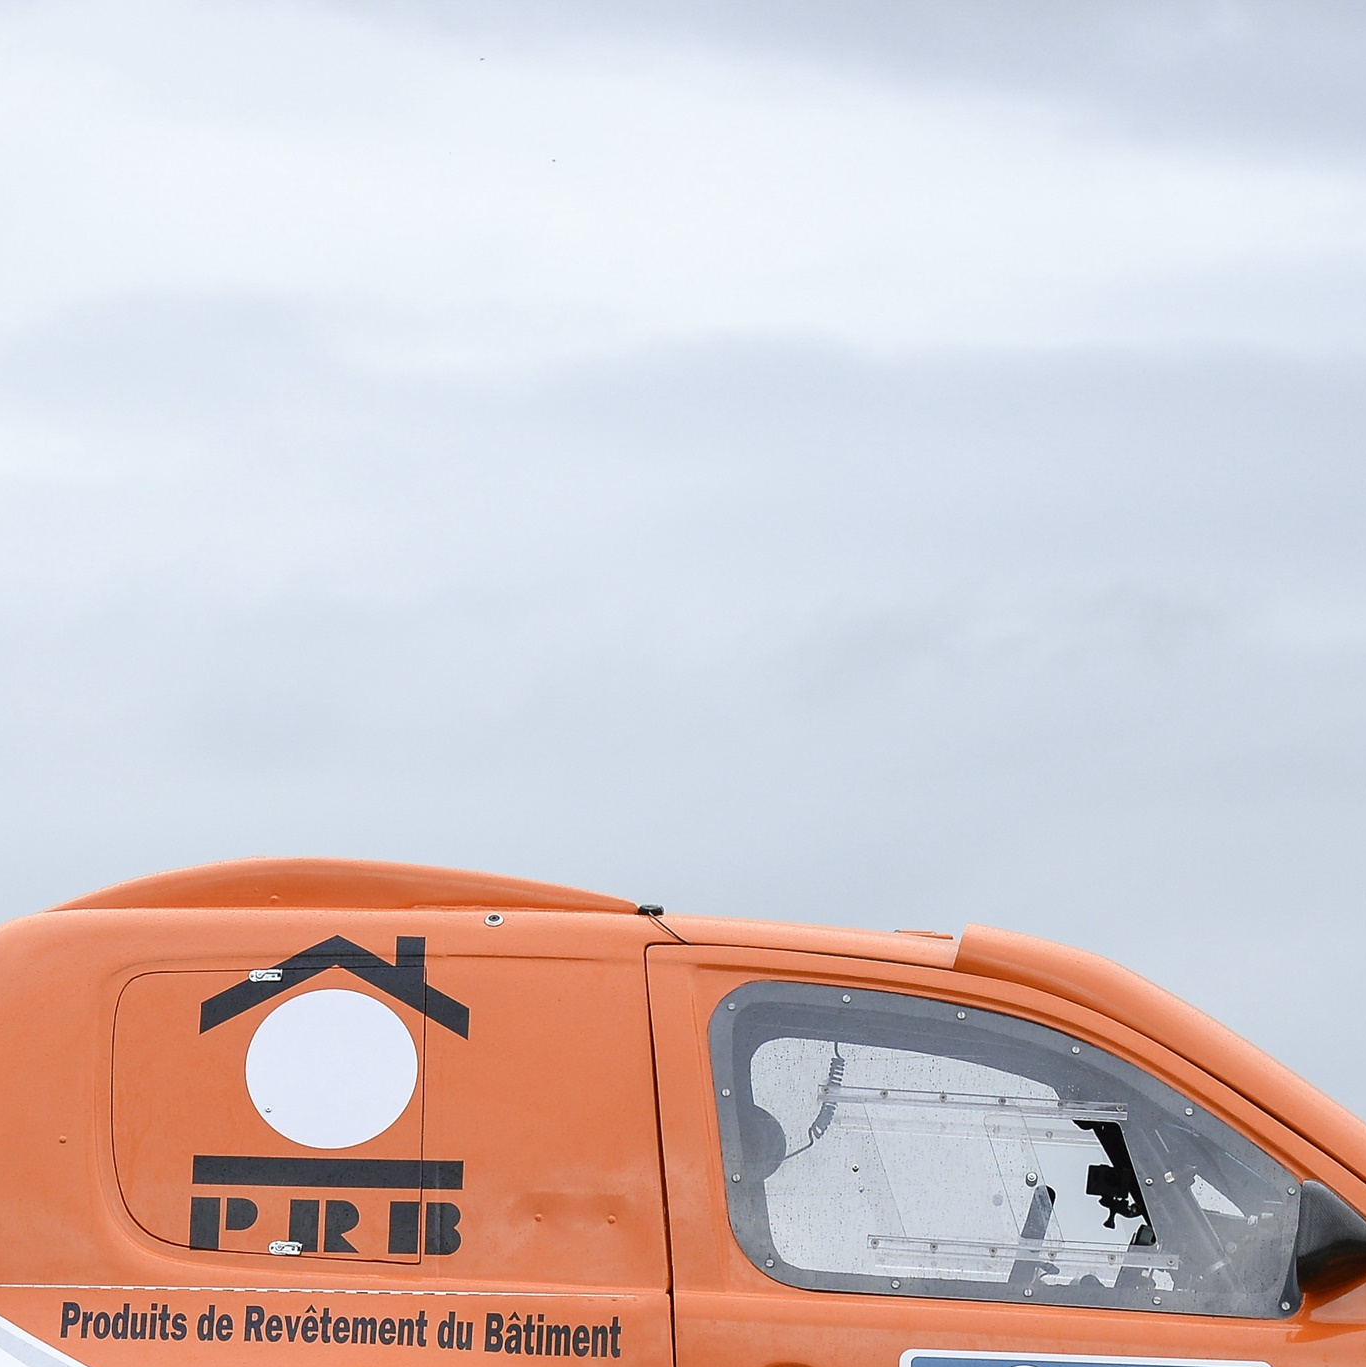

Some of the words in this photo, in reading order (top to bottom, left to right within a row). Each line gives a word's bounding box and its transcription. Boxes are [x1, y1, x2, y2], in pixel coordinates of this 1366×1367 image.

[60, 1302, 188, 1343] Produits
[196, 1304, 234, 1343] de
[243, 1305, 428, 1348] Revêtement
[437, 1310, 472, 1351] du
[484, 1311, 622, 1359] Bâtiment
